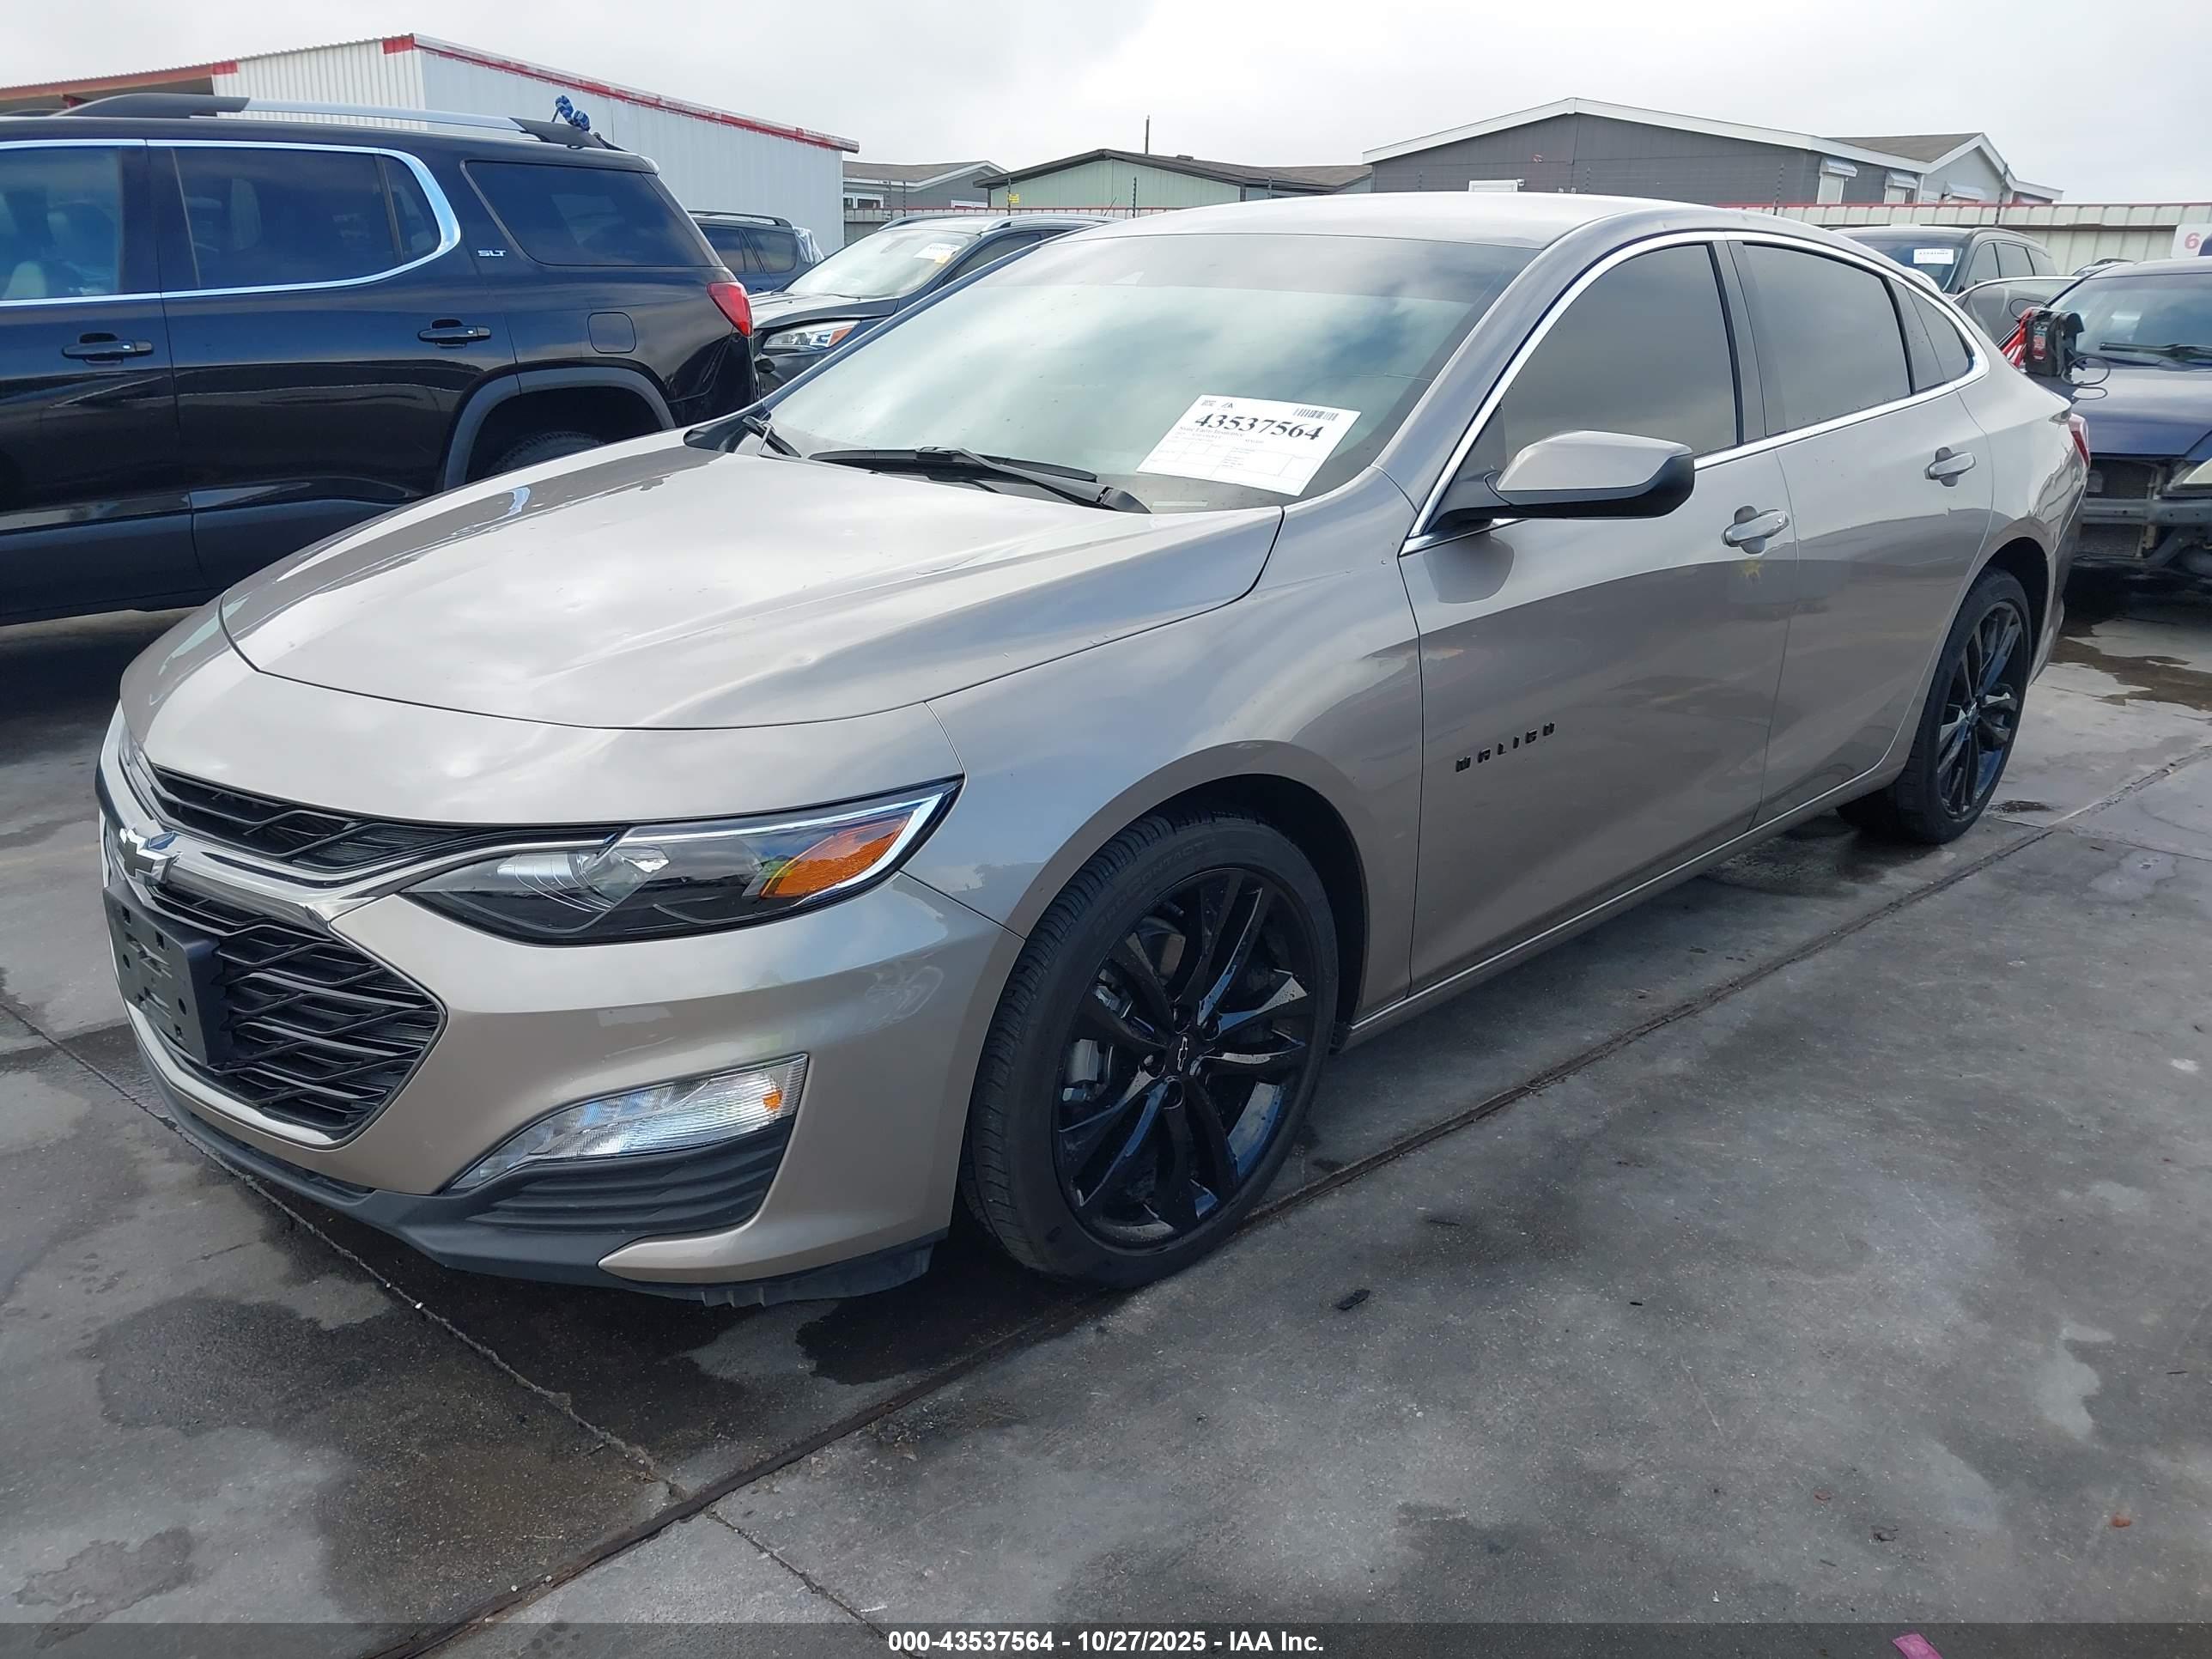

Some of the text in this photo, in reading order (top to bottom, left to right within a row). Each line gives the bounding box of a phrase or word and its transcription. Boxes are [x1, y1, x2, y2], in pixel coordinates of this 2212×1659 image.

[2185, 232, 2200, 249] 6
[477, 249, 507, 258] SLT
[1194, 412, 1325, 441] 43537564
[1455, 721, 1555, 773] MALIBU
